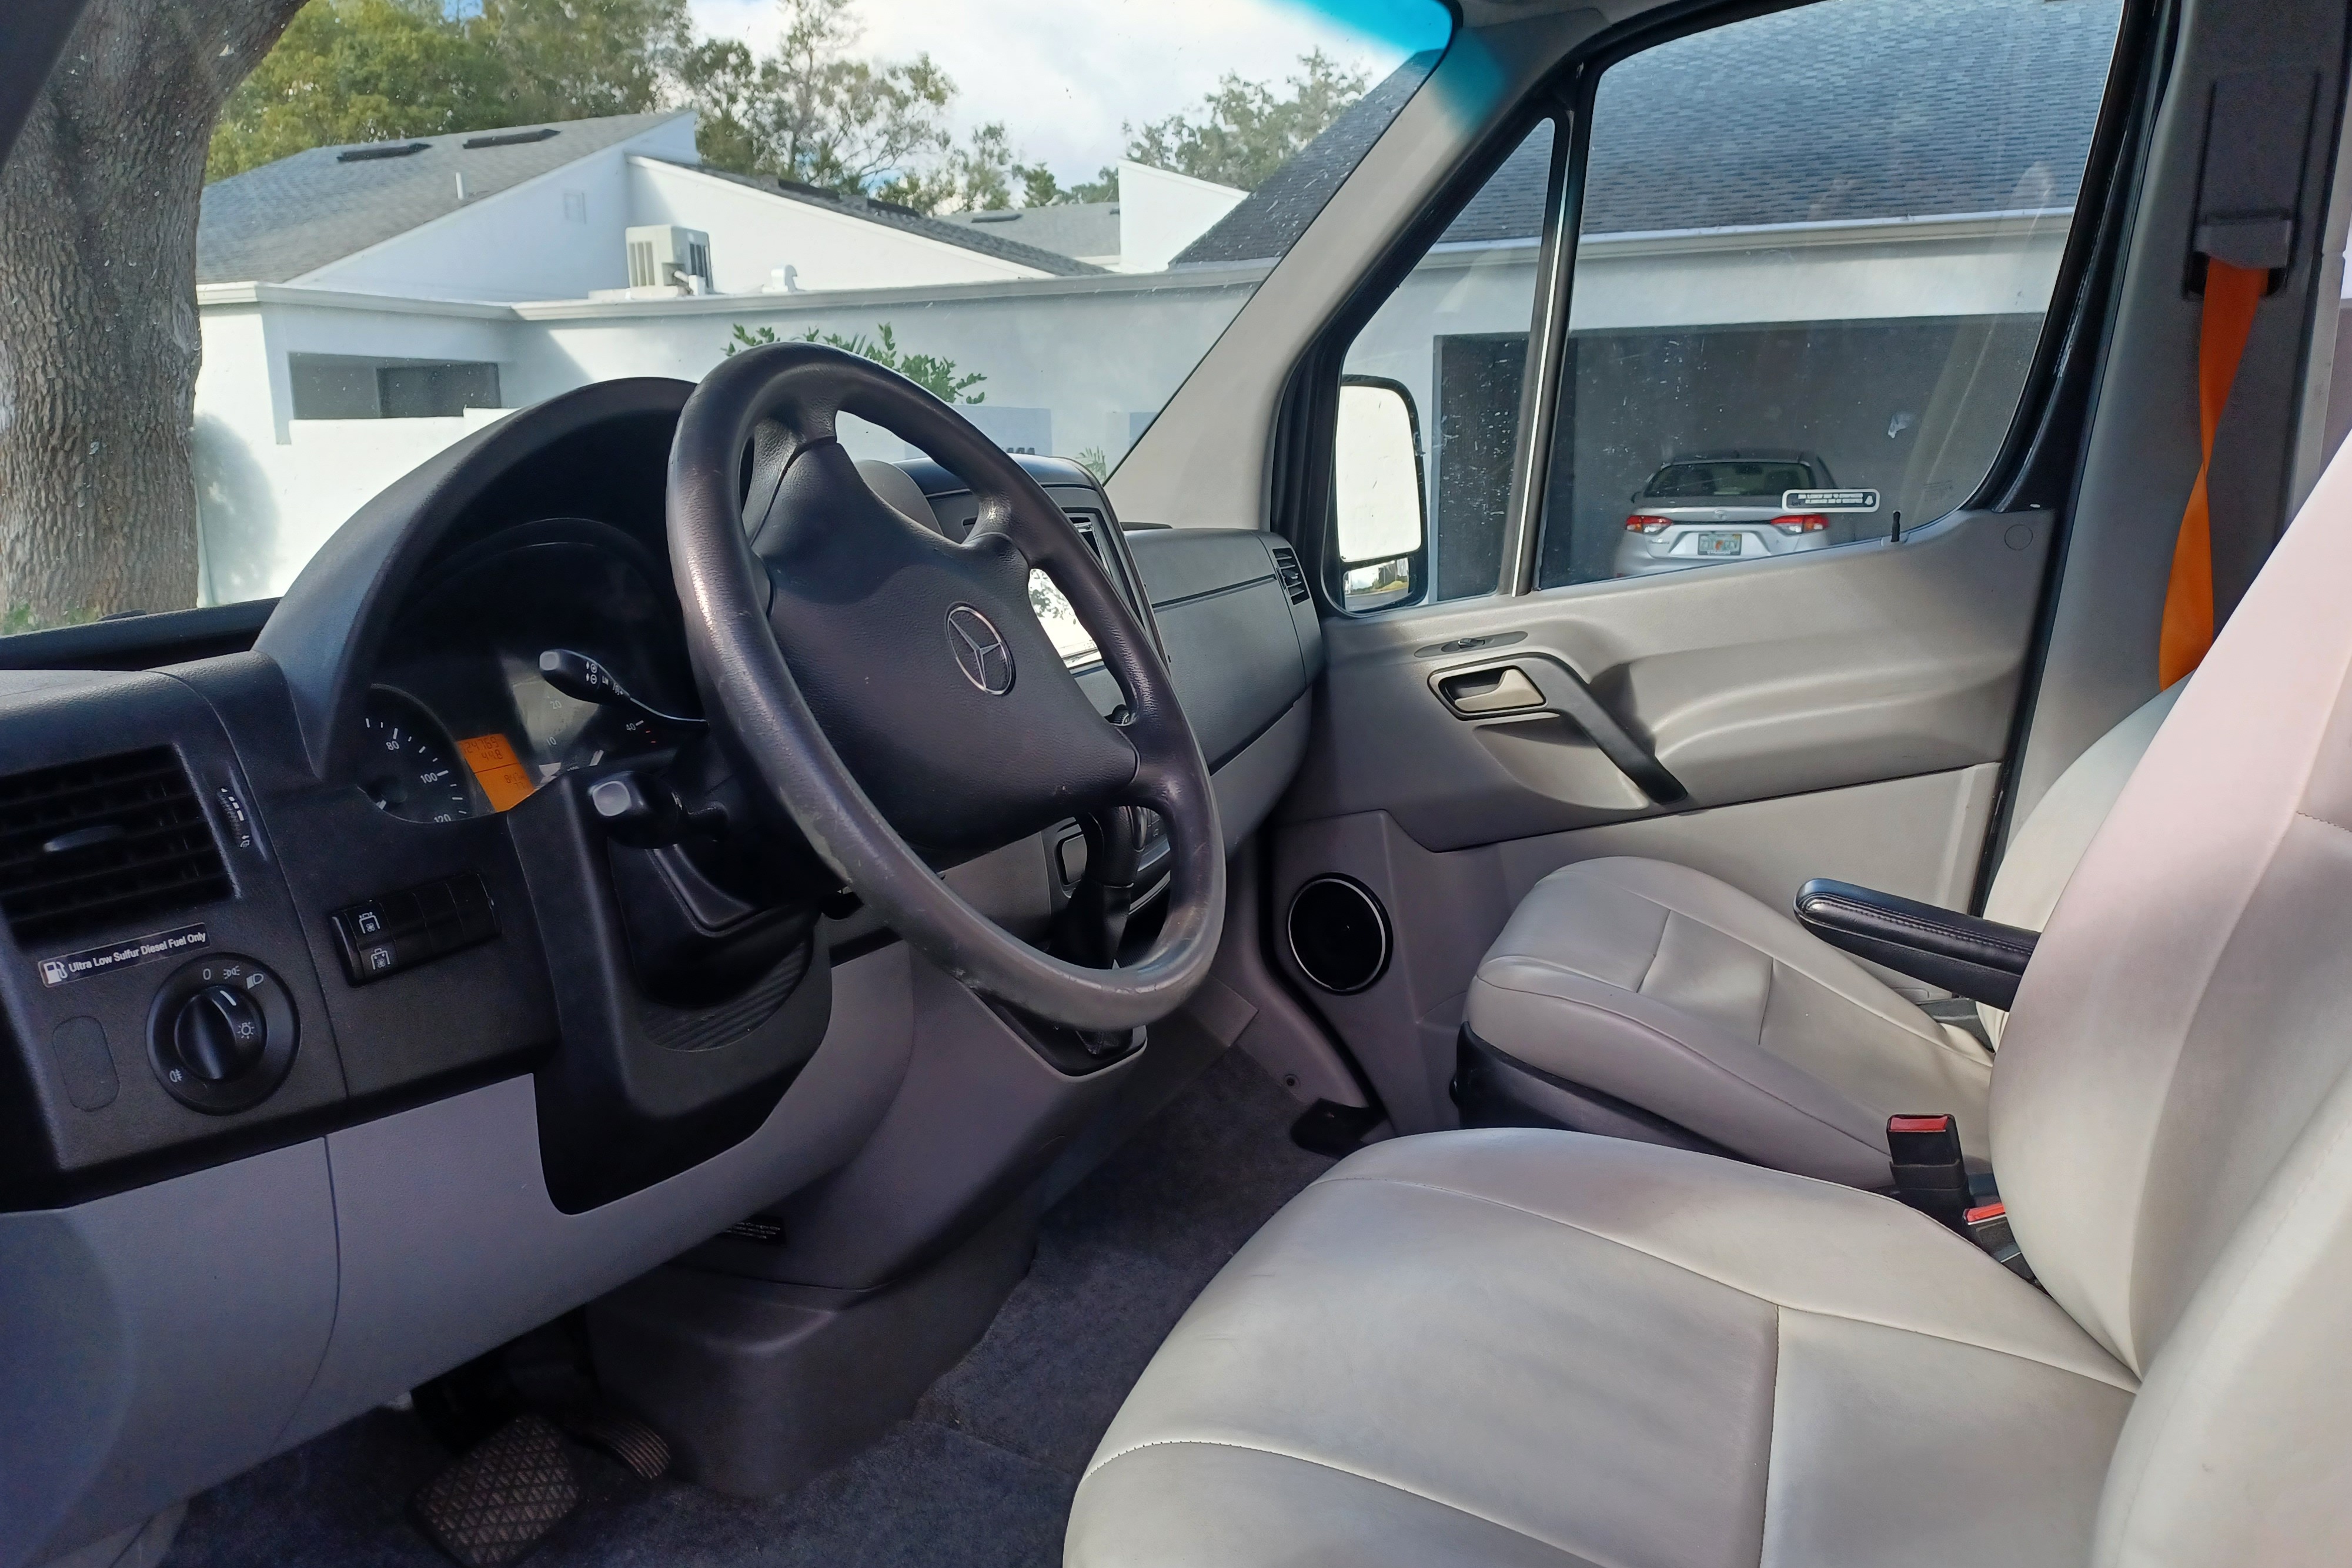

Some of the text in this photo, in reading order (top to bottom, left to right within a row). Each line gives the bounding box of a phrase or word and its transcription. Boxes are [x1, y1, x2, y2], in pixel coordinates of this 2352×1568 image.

[550, 700, 562, 710] 20
[626, 723, 636, 731] 40
[386, 741, 400, 751] 80
[546, 737, 557, 746] 10
[420, 773, 438, 784] 100
[68, 932, 206, 973] Ultra Low Sulfur Diesel Fuel Only
